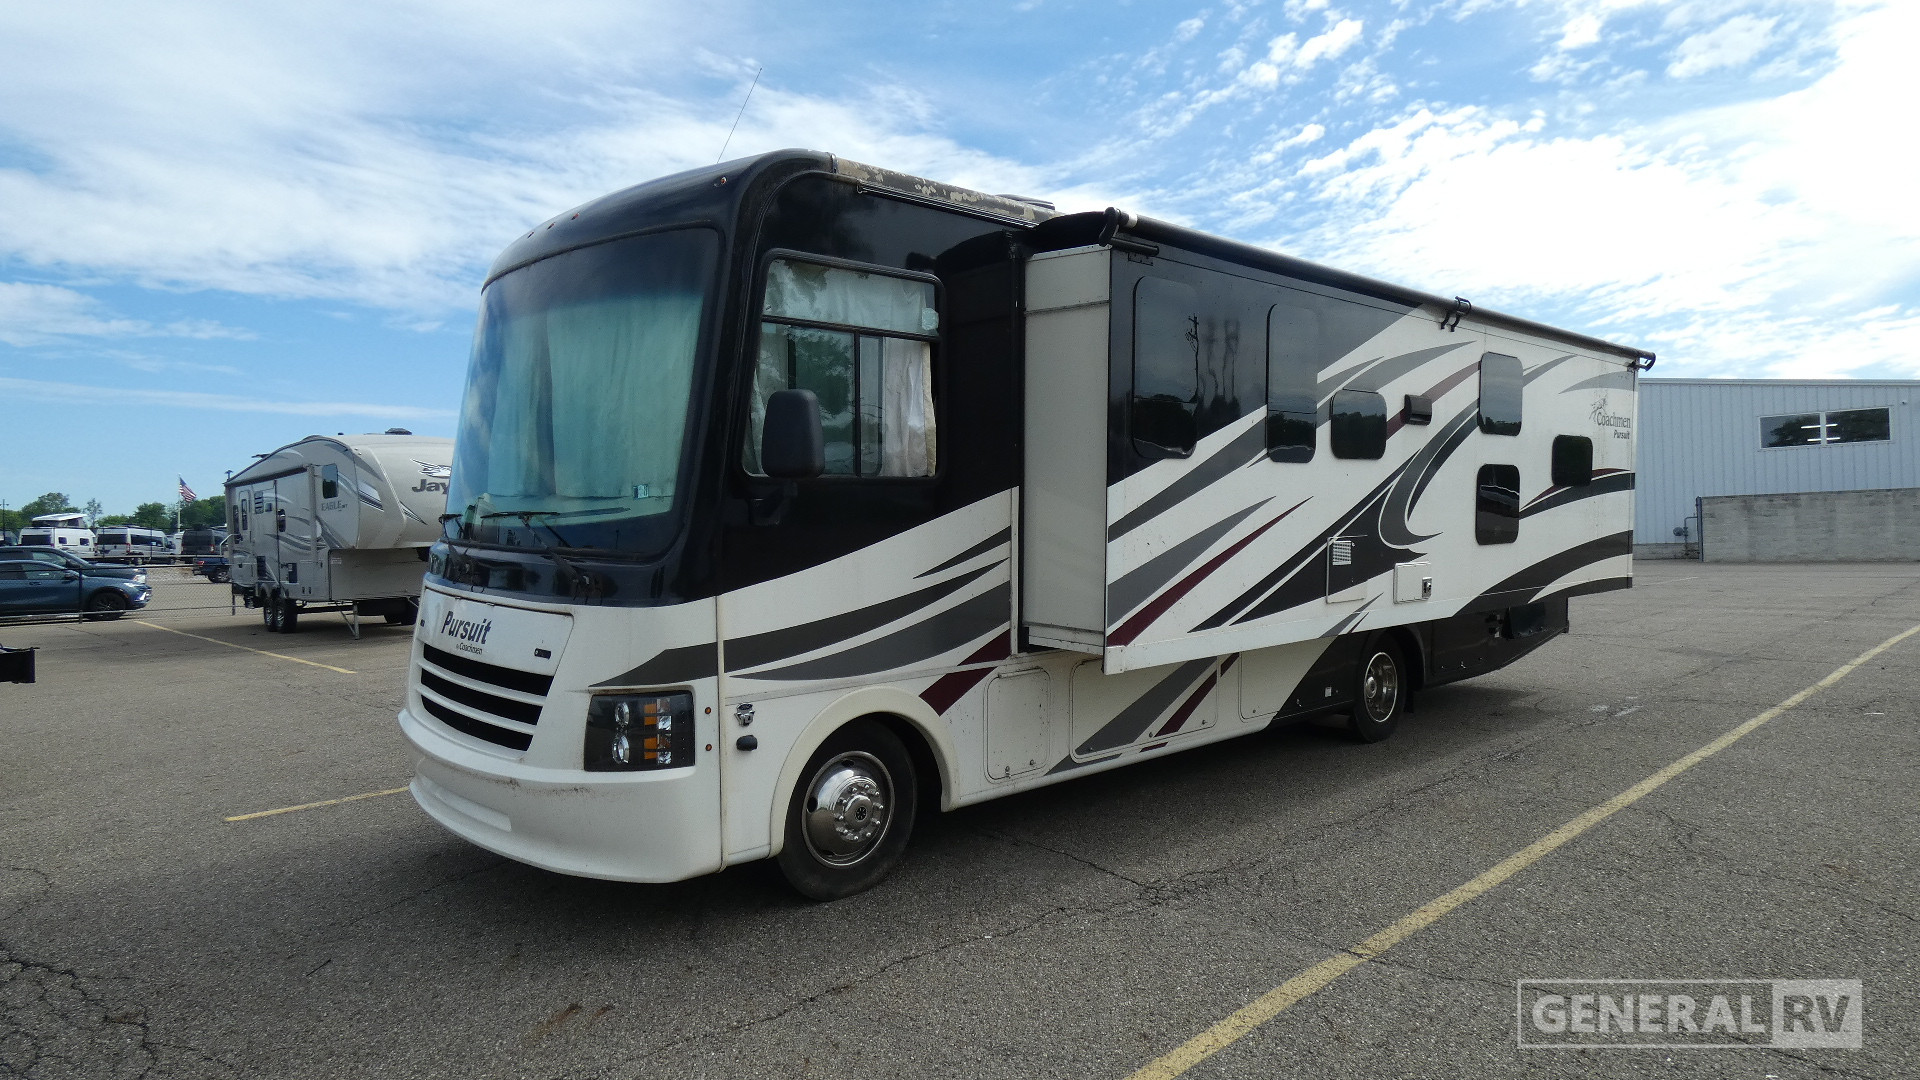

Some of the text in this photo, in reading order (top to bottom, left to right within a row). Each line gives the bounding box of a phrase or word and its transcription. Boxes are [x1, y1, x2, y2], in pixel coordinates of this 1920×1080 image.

[1596, 411, 1631, 429] Coachmen
[1613, 429, 1630, 440] Pursuit
[411, 478, 450, 495] Jay
[321, 500, 342, 511] EAGLE
[441, 610, 492, 645] Pursuit
